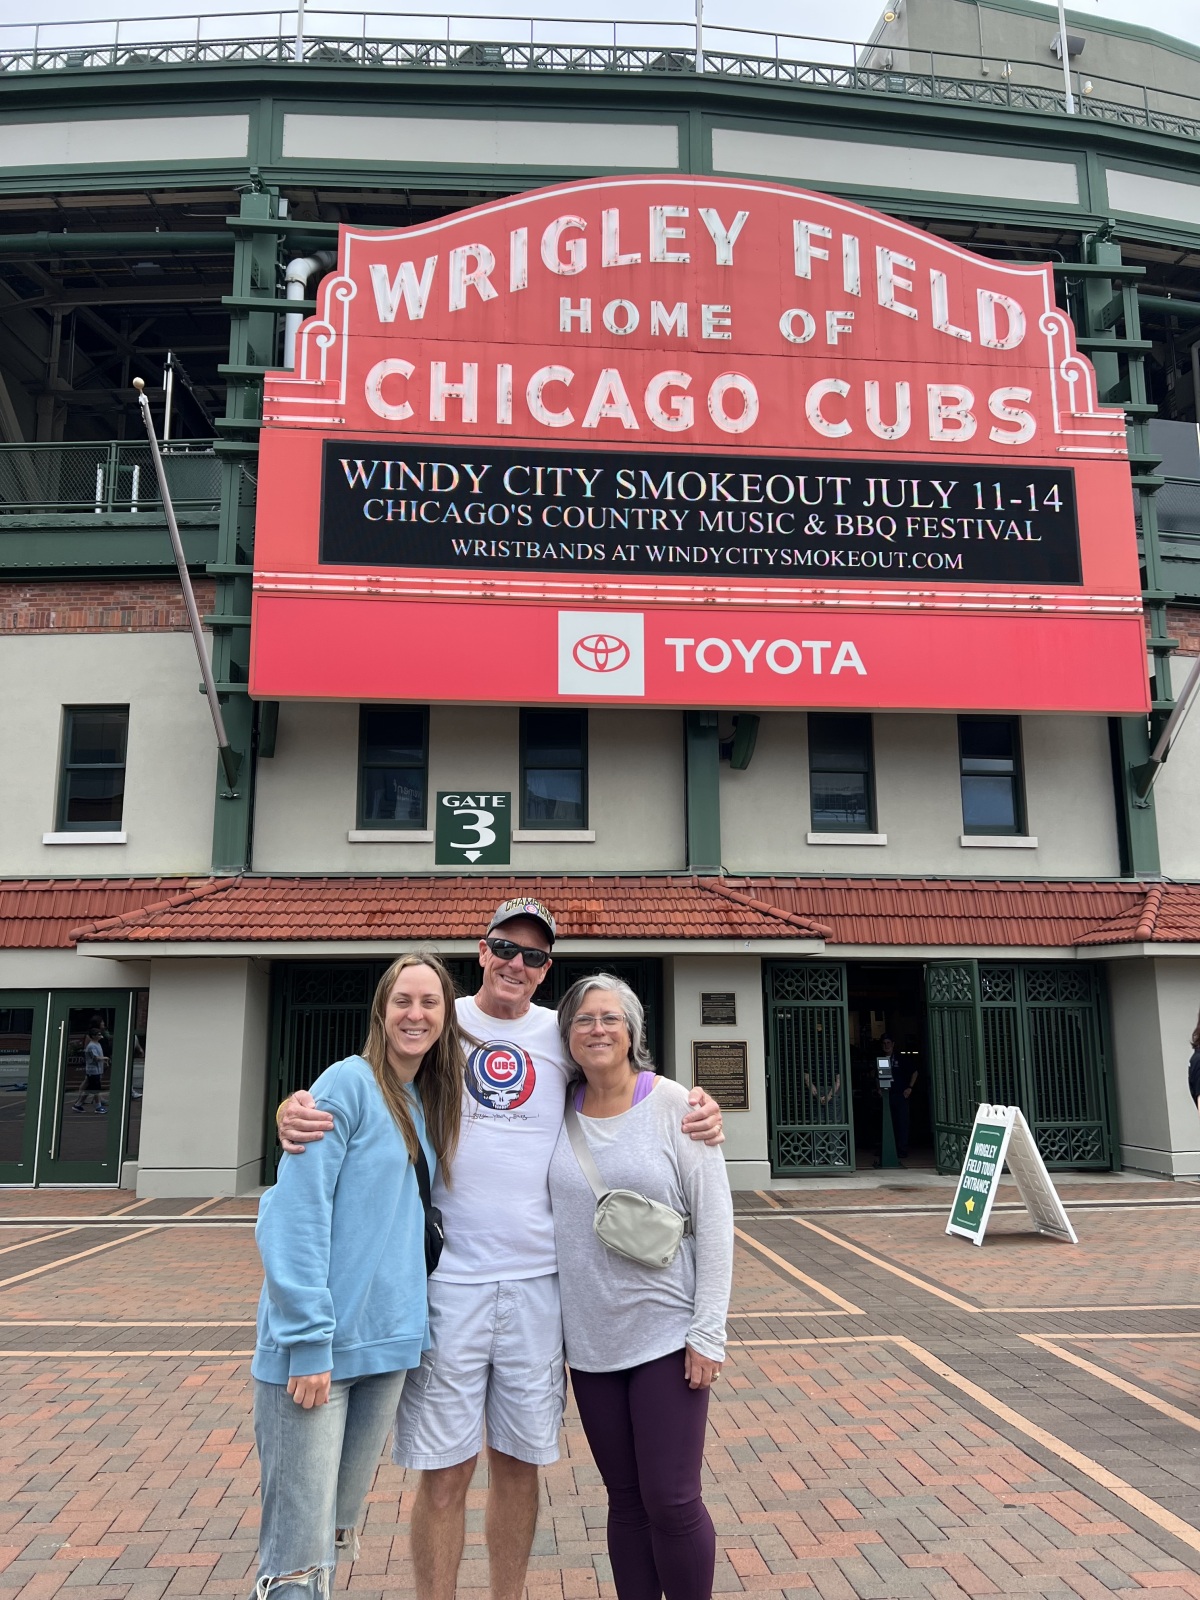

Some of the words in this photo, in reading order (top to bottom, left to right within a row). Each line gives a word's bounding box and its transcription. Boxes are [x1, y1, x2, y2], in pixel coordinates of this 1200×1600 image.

[369, 206, 750, 323] WRIGLEY
[793, 219, 1027, 351] FIELD
[559, 297, 732, 340] HOME
[778, 308, 855, 345] OF
[365, 358, 759, 434] CHICAGO
[804, 378, 1037, 445] CUBS
[338, 458, 492, 494] WINDY
[503, 465, 604, 498] CITY
[615, 469, 852, 507] SMOKEOUT
[862, 478, 959, 509] JULY
[973, 481, 1064, 513] 11-14
[363, 499, 533, 527] CHICAGO'S
[542, 505, 690, 531] COUNTRY
[699, 511, 795, 535] MUSIC
[804, 514, 827, 535] &
[835, 514, 897, 543] BBQ
[905, 516, 1042, 541] FESTIVAL
[451, 538, 606, 561] WRISTBANDS
[611, 544, 640, 561] AT
[645, 545, 964, 570] WINDYCITYSMOKEOUT.COM
[664, 637, 868, 676] TOYOTA
[442, 795, 506, 808] GATE
[450, 809, 497, 849] 3
[486, 1050, 517, 1081] CUBS
[966, 1159, 982, 1173] FIELD
[980, 1162, 996, 1177] TOUR
[973, 1142, 998, 1158] WRIGLEY
[962, 1176, 991, 1195] ENTRANCE
